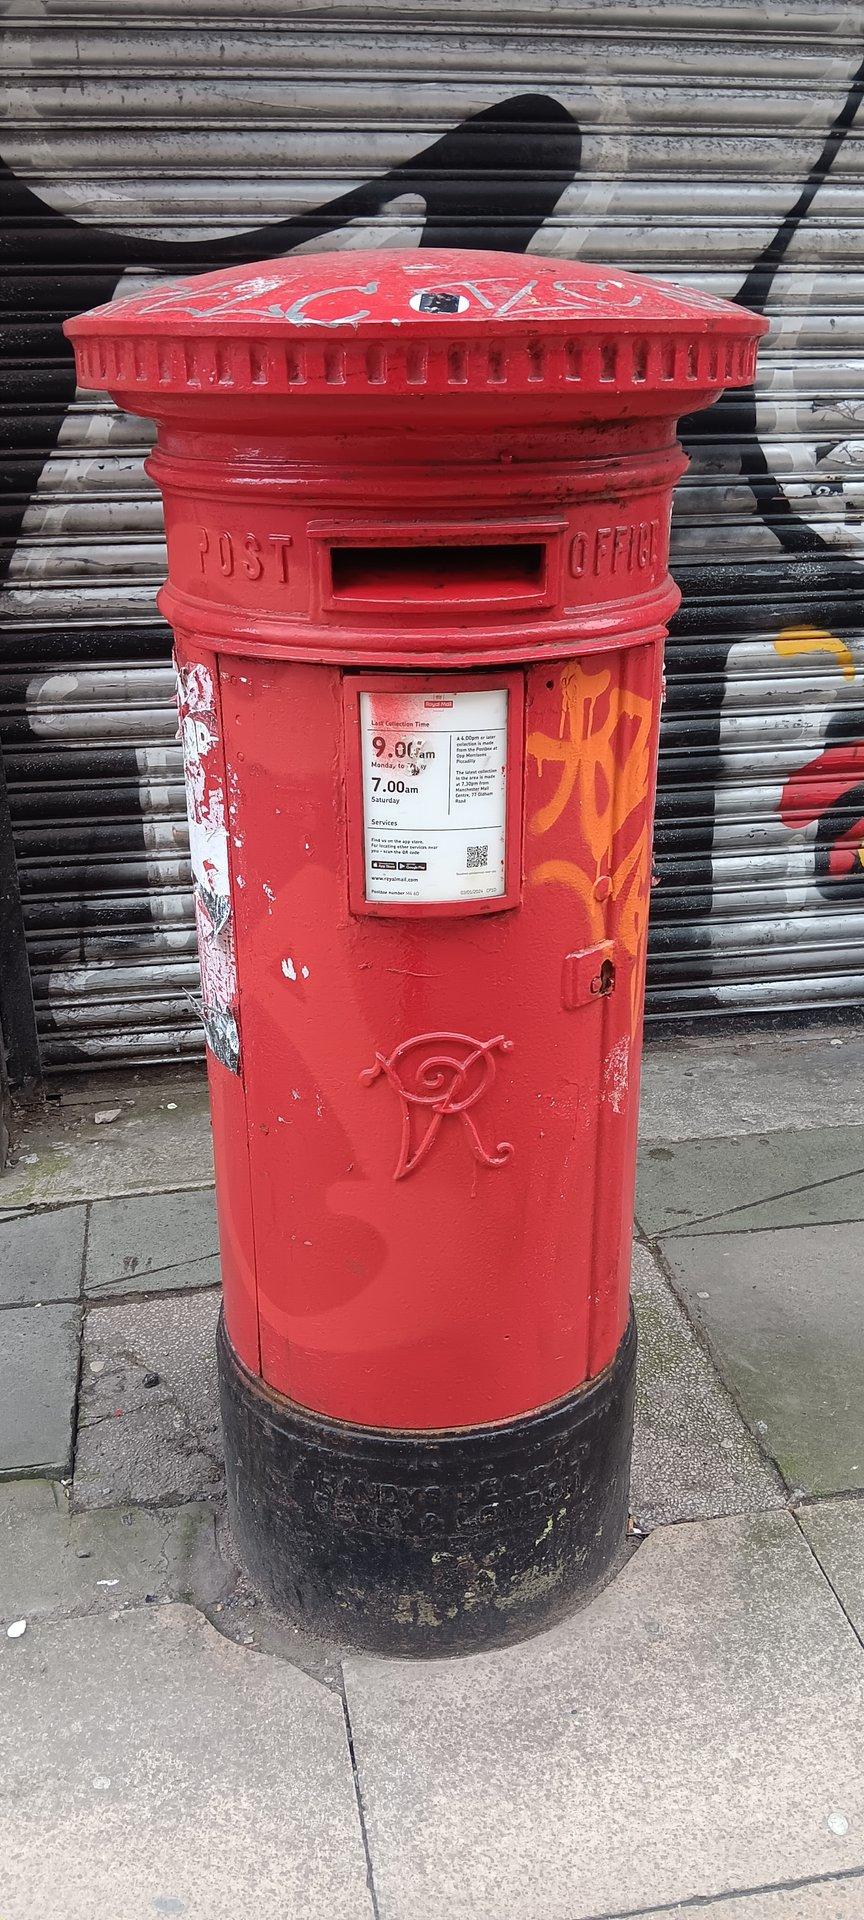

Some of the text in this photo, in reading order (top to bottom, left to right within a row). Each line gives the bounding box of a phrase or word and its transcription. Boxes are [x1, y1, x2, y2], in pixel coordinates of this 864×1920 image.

[198, 526, 292, 584] POST
[570, 519, 658, 579] OFFICE
[371, 796, 400, 804] Saturday
[372, 777, 419, 793] 7.00am
